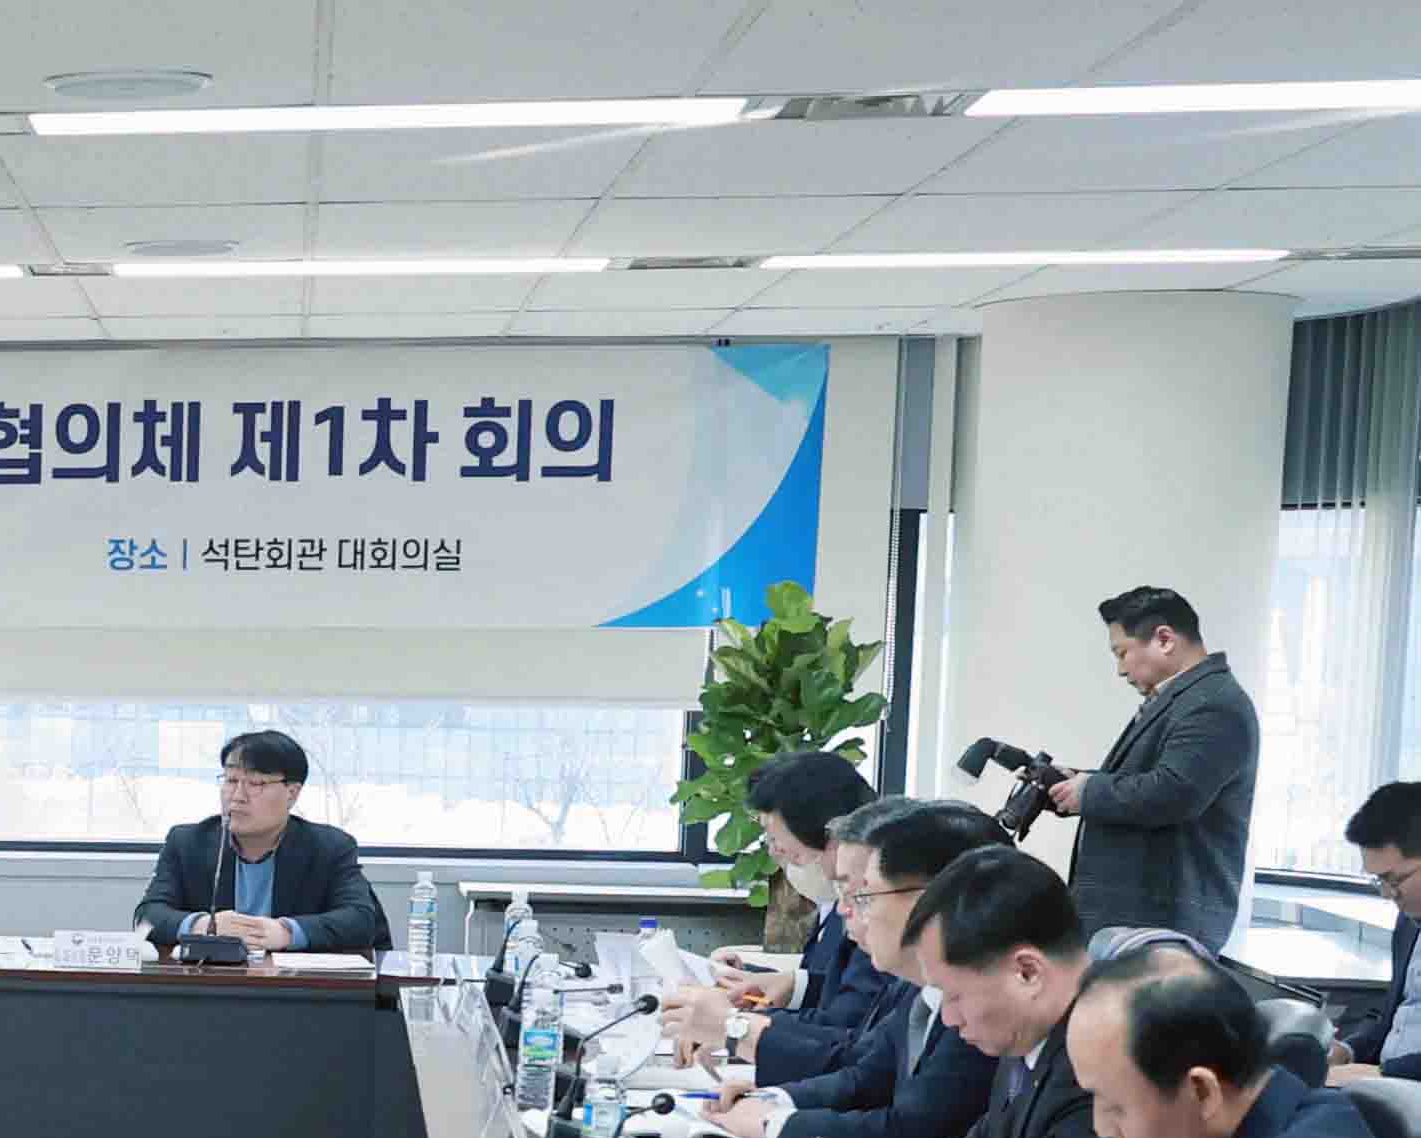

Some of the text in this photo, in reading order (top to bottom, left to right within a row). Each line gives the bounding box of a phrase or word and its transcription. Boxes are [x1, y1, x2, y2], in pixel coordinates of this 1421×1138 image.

[229, 396, 441, 484] 제1차
[458, 395, 616, 484] 회의
[106, 536, 463, 573] 장소 석탄회관 대회의실
